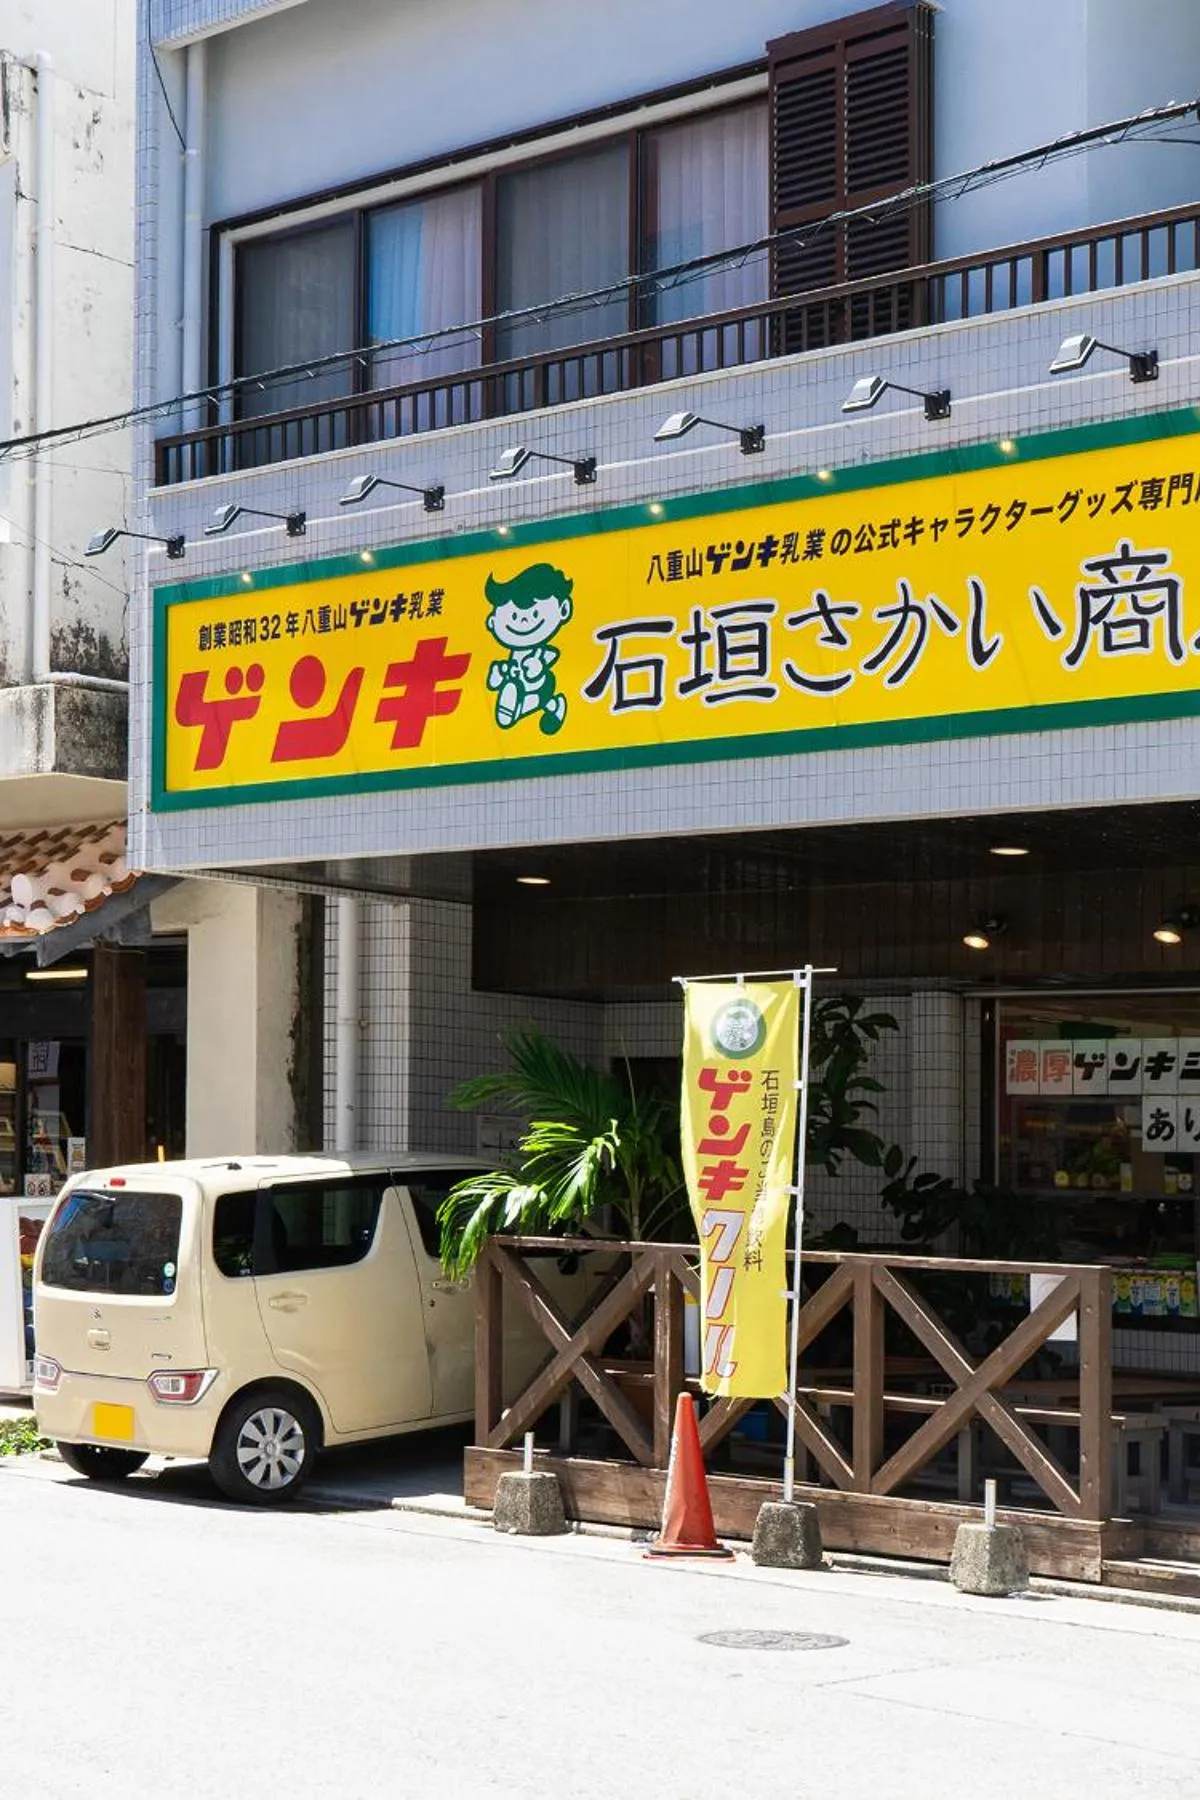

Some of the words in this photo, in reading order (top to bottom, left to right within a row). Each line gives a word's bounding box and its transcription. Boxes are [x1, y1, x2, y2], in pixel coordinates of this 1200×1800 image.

[197, 588, 445, 652] 創業昭和32年八重山ゲンキ乳業
[175, 635, 473, 772] ゲンキ
